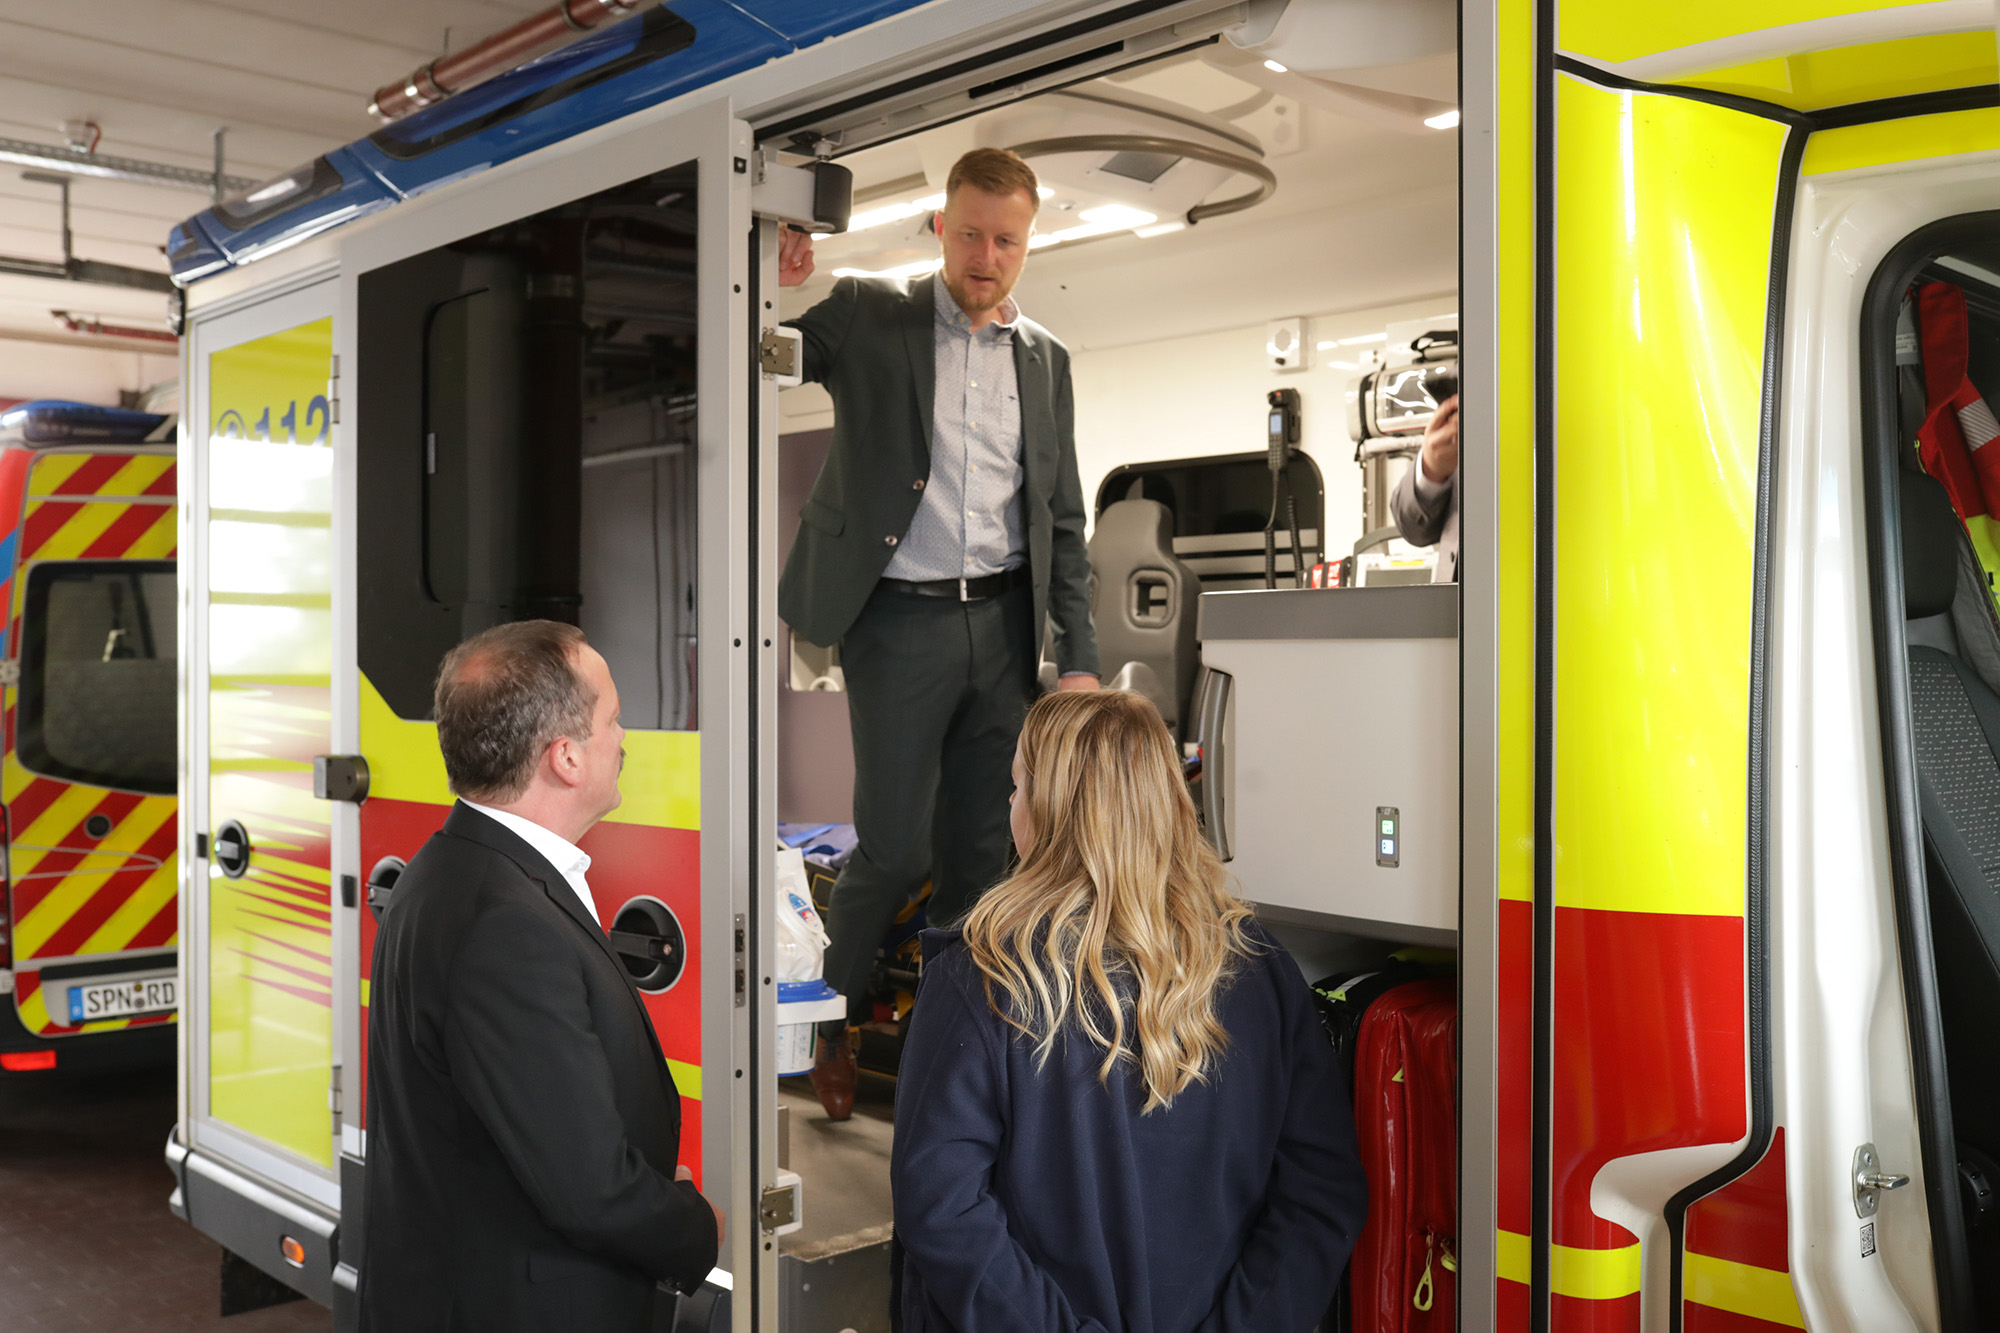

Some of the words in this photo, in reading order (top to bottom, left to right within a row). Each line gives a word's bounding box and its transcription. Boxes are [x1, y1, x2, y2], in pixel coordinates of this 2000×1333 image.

[255, 394, 330, 446] 112
[87, 986, 131, 1013] SPN
[147, 982, 175, 1005] RD
